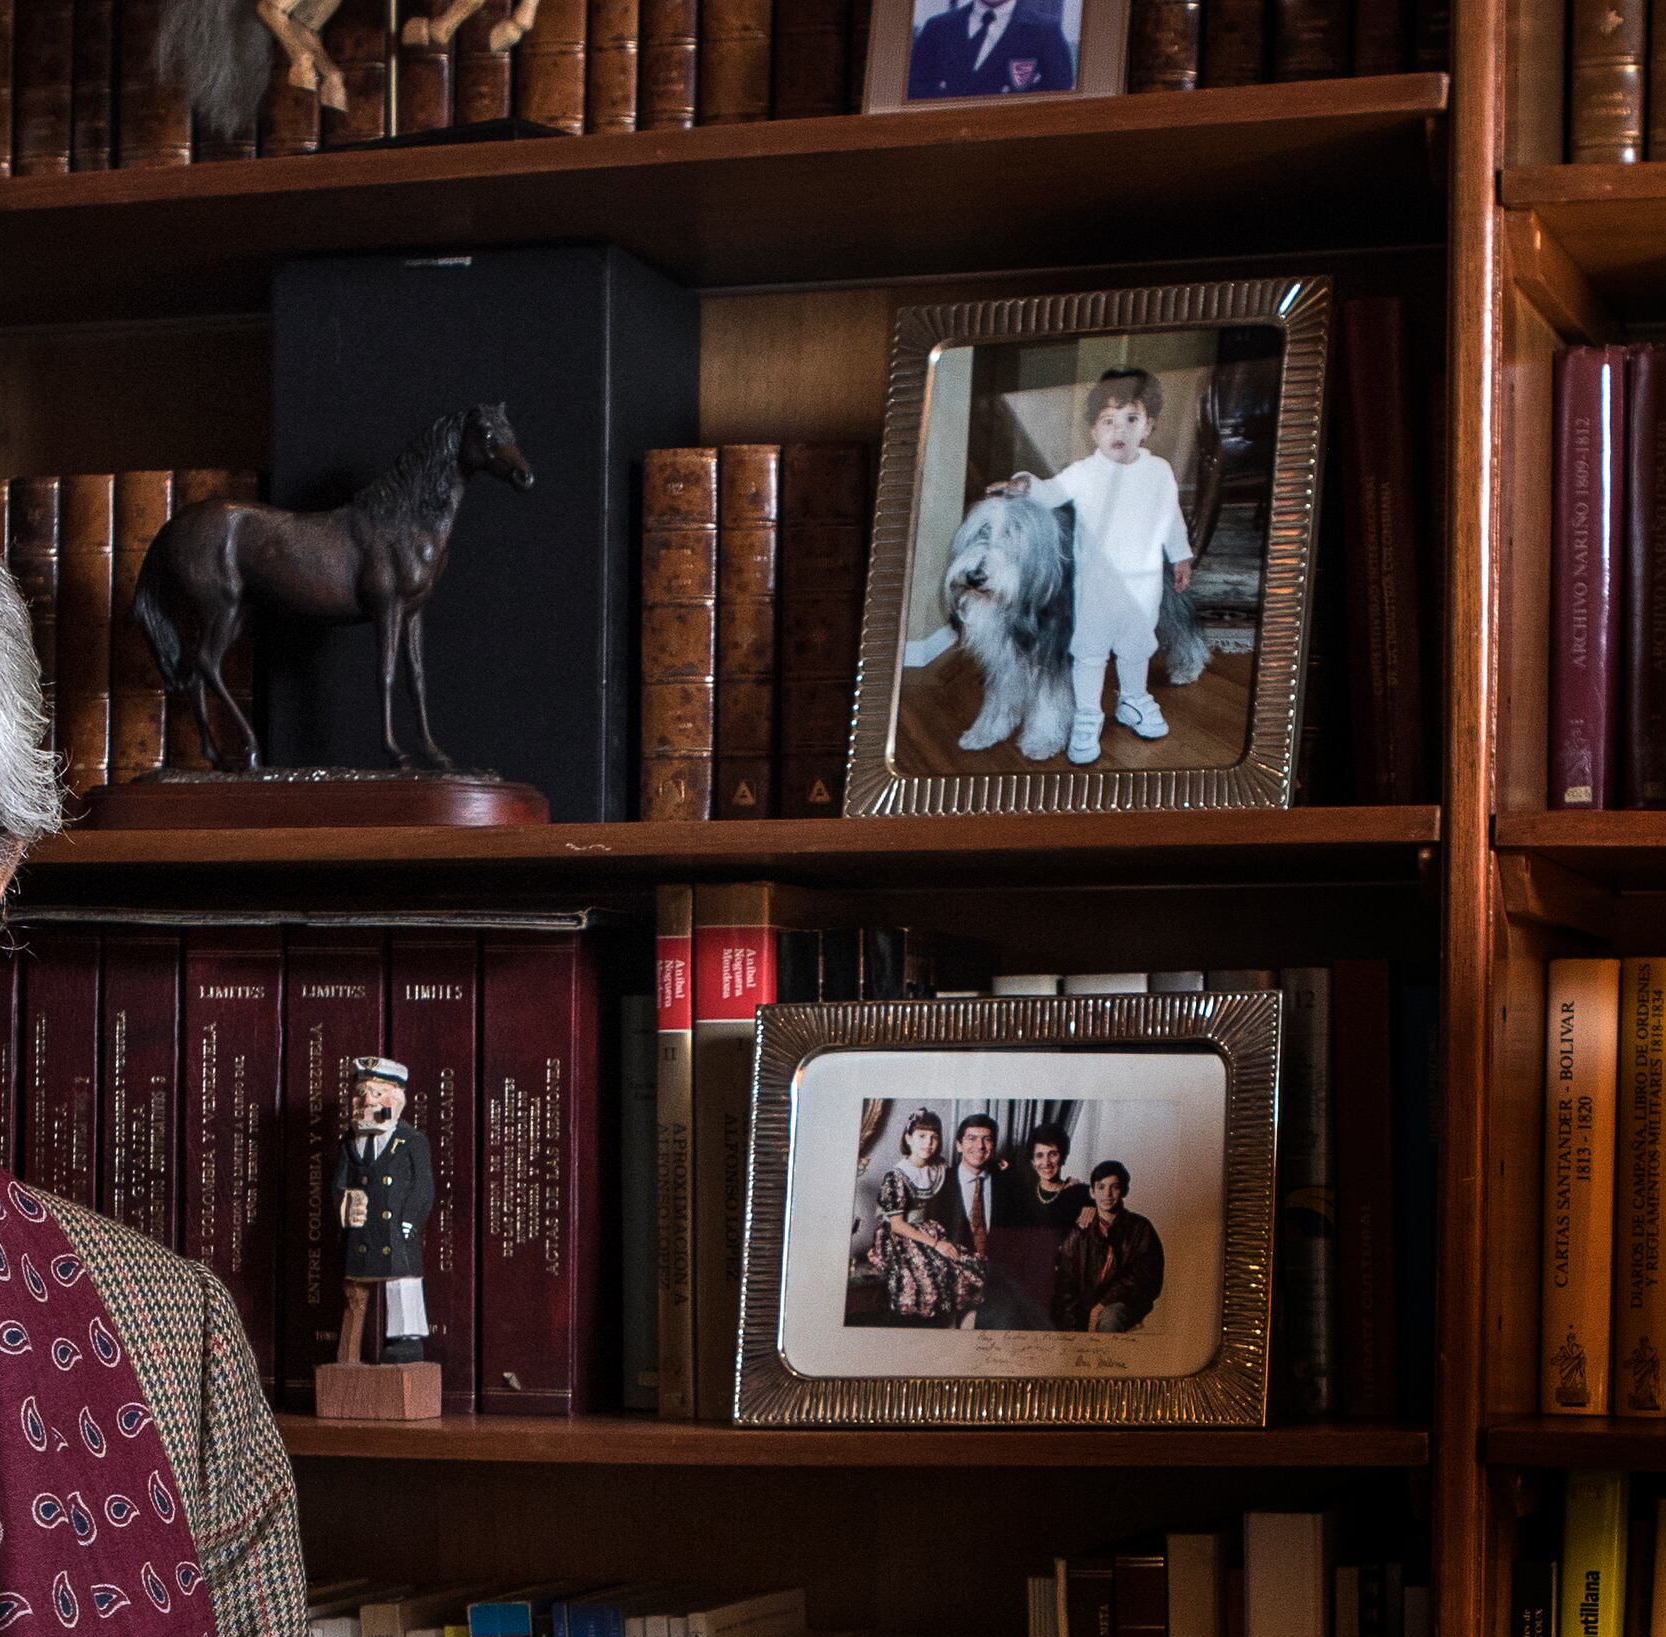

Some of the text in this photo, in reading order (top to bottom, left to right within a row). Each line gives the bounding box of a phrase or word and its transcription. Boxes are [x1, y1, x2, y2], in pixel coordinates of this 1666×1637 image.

[1572, 504, 1588, 575] NARIÑO
[1572, 581, 1588, 667] ARCHIVO
[199, 985, 265, 1000] LIMITES
[301, 985, 366, 1000] LIMITES
[404, 985, 463, 1000] LIMITES
[663, 959, 675, 1008] Noguera
[733, 947, 746, 998] Noguera
[1636, 964, 1650, 1039] ORDENES
[1559, 1001, 1574, 1081] BOLIVAR
[1635, 1045, 1647, 1066] DE
[202, 1020, 216, 1237] COLOMBIA Y VENEZUELA
[1634, 1072, 1647, 1121] LIBRO
[307, 1022, 323, 1304] ENTRE COLOMBIA Y VENEZUELA
[546, 1057, 561, 1276] ACTAS DE LAS SESIONES
[1557, 1099, 1573, 1209] SANTANDER
[1646, 990, 1663, 1287] Y REGLAMENTOS MILITARES 1818-1834
[672, 1122, 688, 1306] APROXIMACION A
[723, 1112, 741, 1282] ALFONSO LOPEZ
[1631, 1216, 1644, 1237] DE
[1554, 1216, 1570, 1288] CARTAS
[1631, 1242, 1644, 1308] DIARIOS
[1522, 1608, 1531, 1621] de
